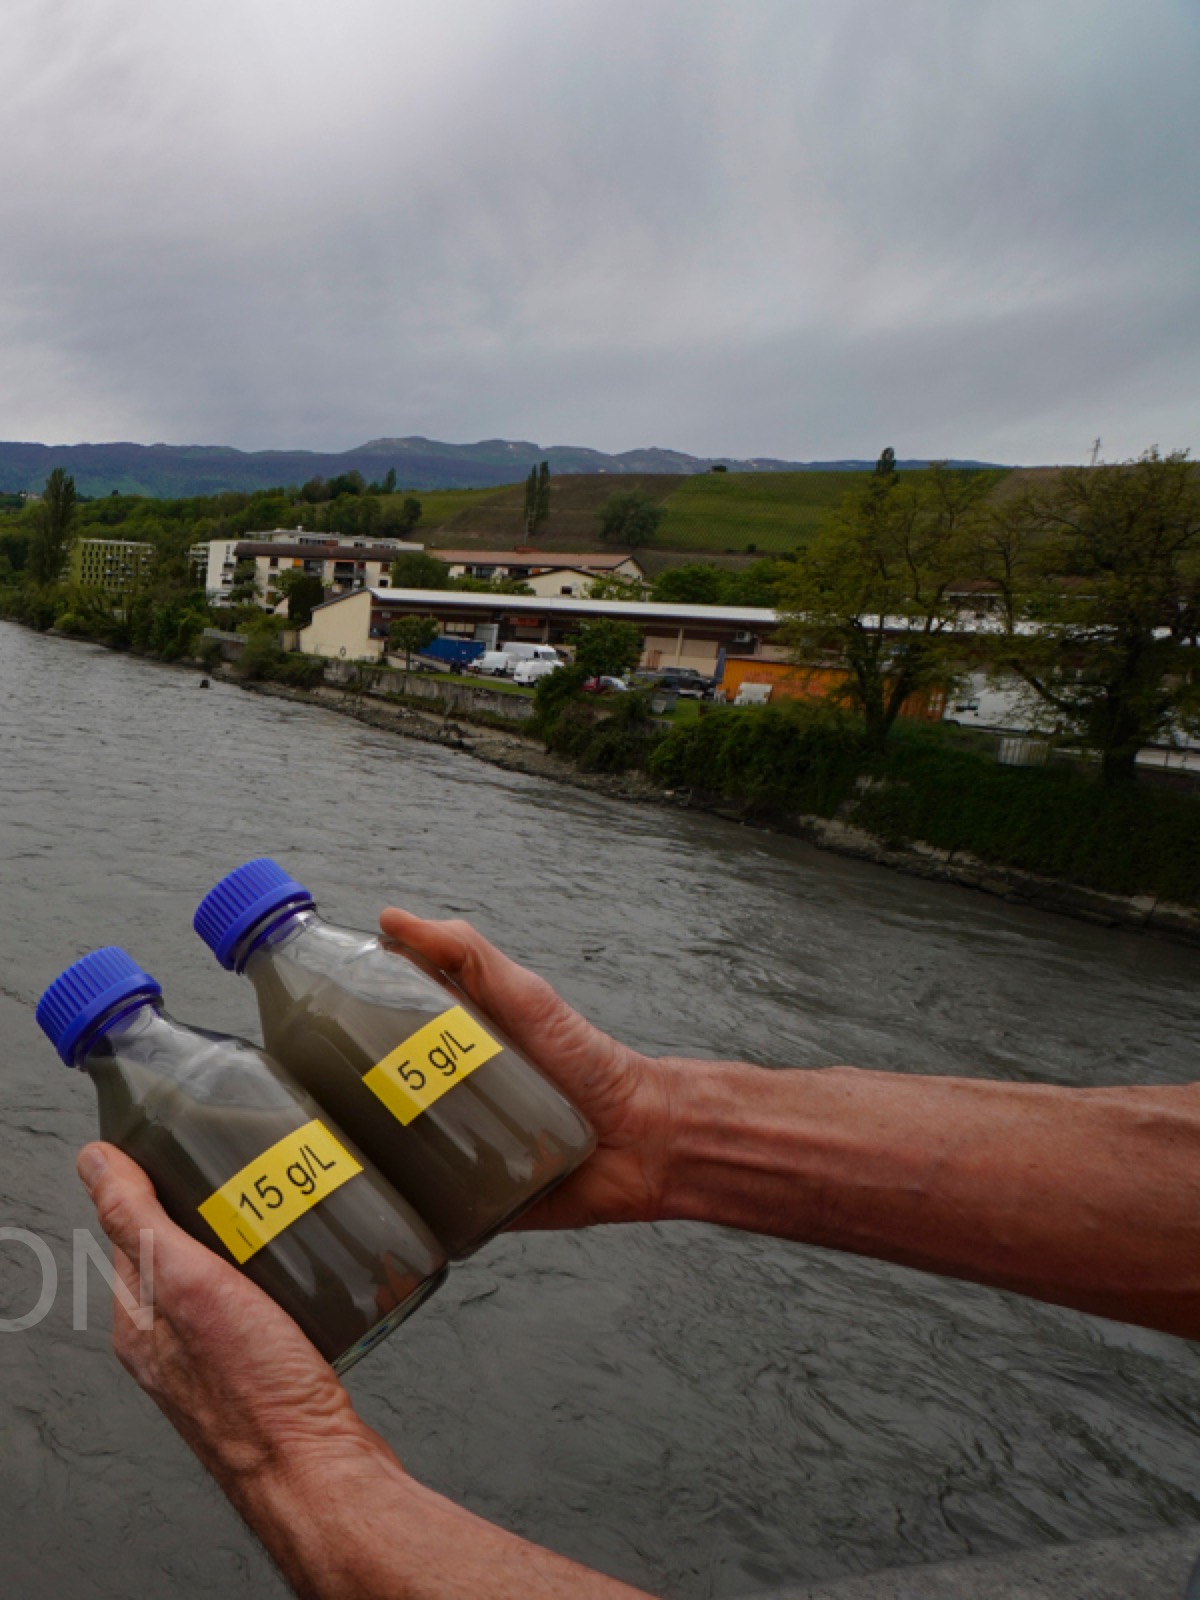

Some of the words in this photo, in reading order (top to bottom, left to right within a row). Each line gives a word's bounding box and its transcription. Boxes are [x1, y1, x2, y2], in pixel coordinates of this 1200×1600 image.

[397, 1059, 426, 1091] 5
[428, 1029, 476, 1076] g/L
[239, 1173, 284, 1221] 15
[286, 1144, 337, 1195] g/L
